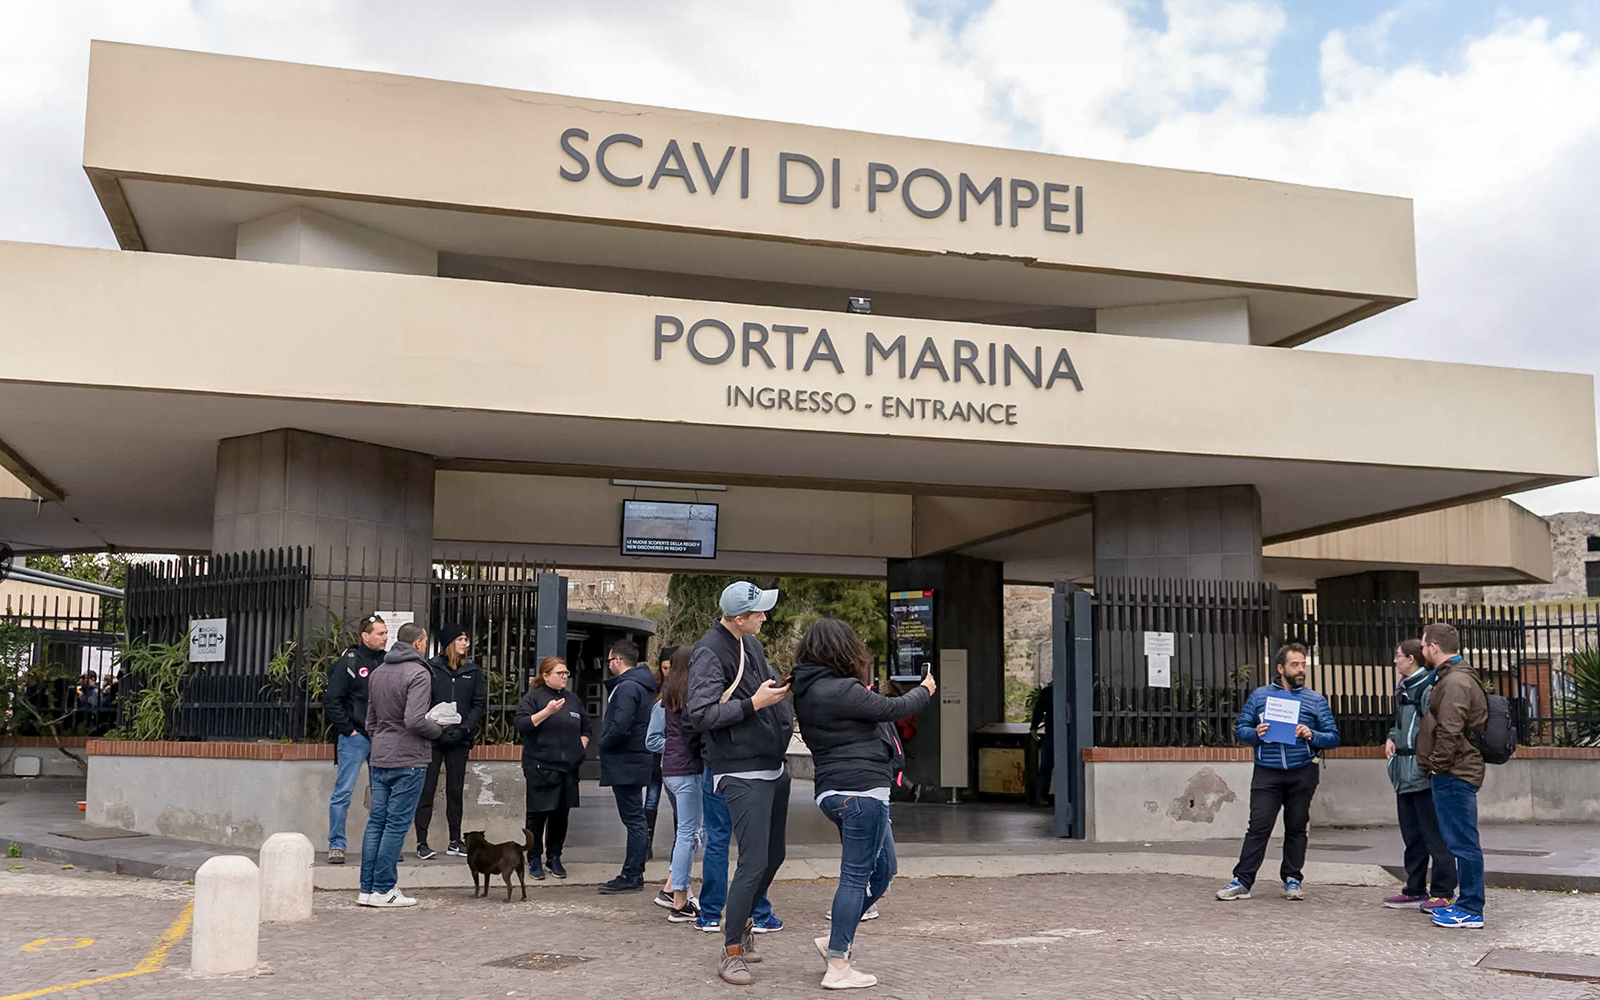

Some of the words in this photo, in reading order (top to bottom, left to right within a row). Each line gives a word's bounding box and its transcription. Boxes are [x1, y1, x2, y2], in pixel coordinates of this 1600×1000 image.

[559, 128, 750, 199] SCAVI
[779, 152, 841, 208] DI
[868, 161, 1083, 234] POMPEI
[654, 314, 845, 374] PORTA
[865, 331, 1084, 391] MARINA
[726, 384, 856, 415] INGRESSO
[881, 396, 1018, 425] ENTRANCE
